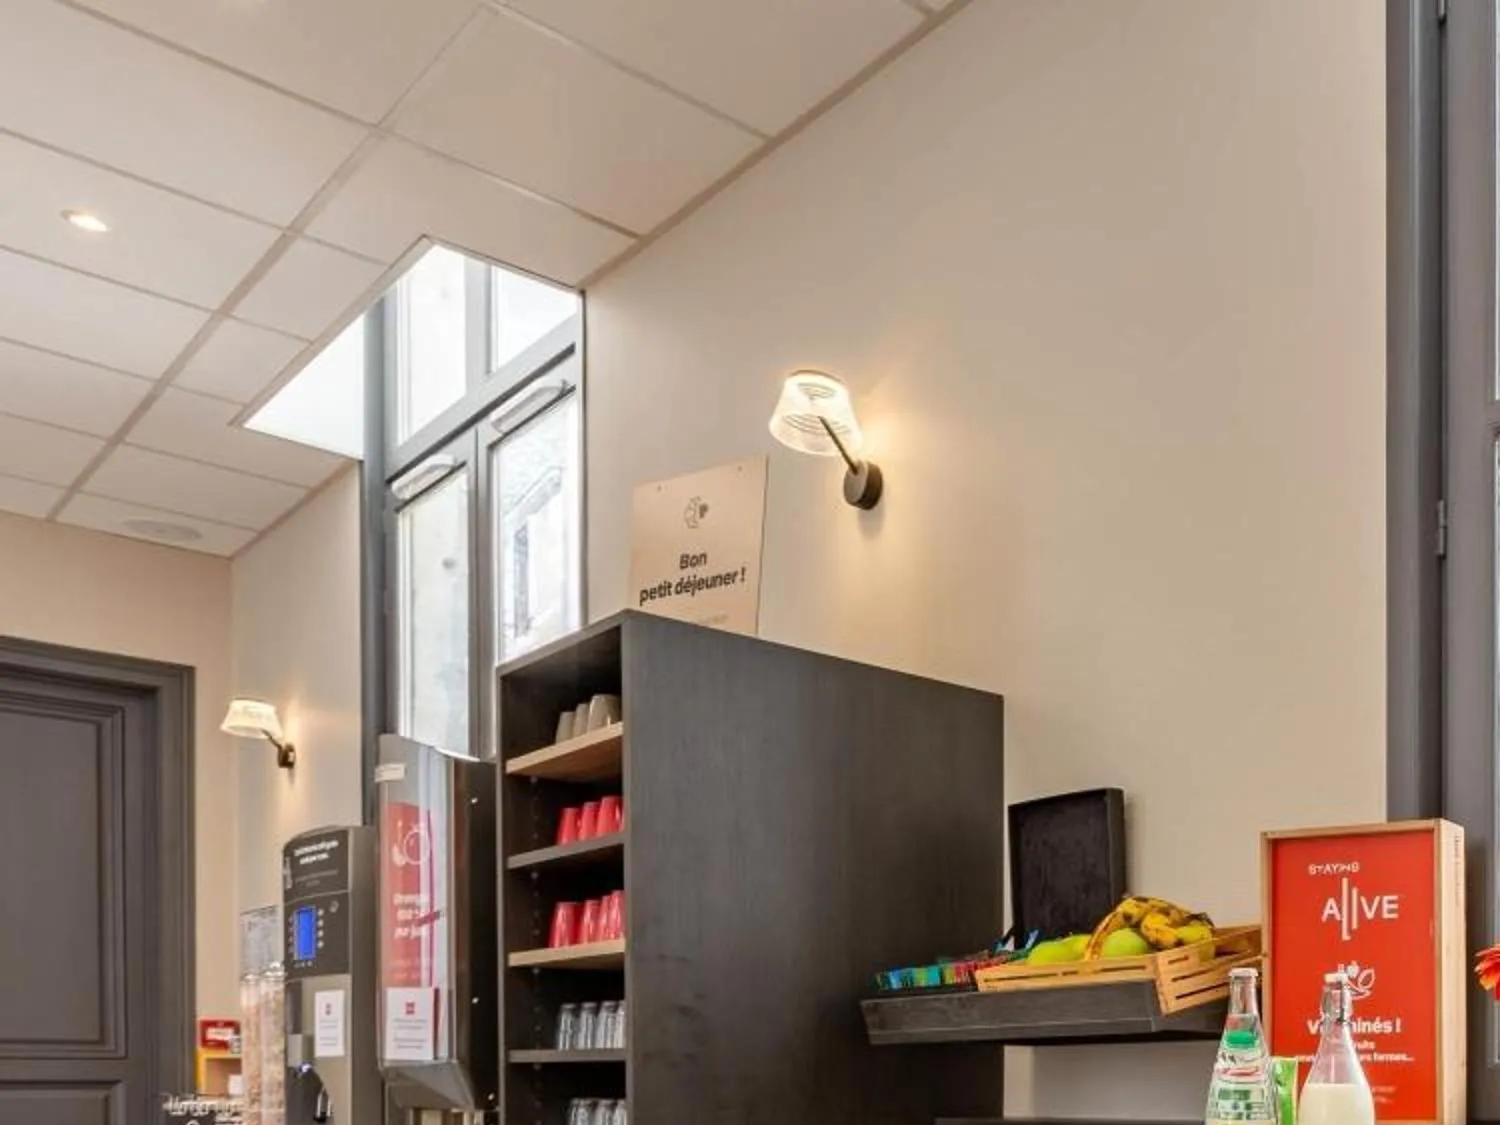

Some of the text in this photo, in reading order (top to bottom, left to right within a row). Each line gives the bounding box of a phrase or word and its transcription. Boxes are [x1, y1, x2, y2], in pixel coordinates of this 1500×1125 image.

[679, 552, 707, 570] Bon
[639, 580, 672, 607] petit
[674, 570, 738, 597] déjeuner
[1308, 861, 1360, 876] STAYING
[1321, 877, 1399, 941] ALIVE
